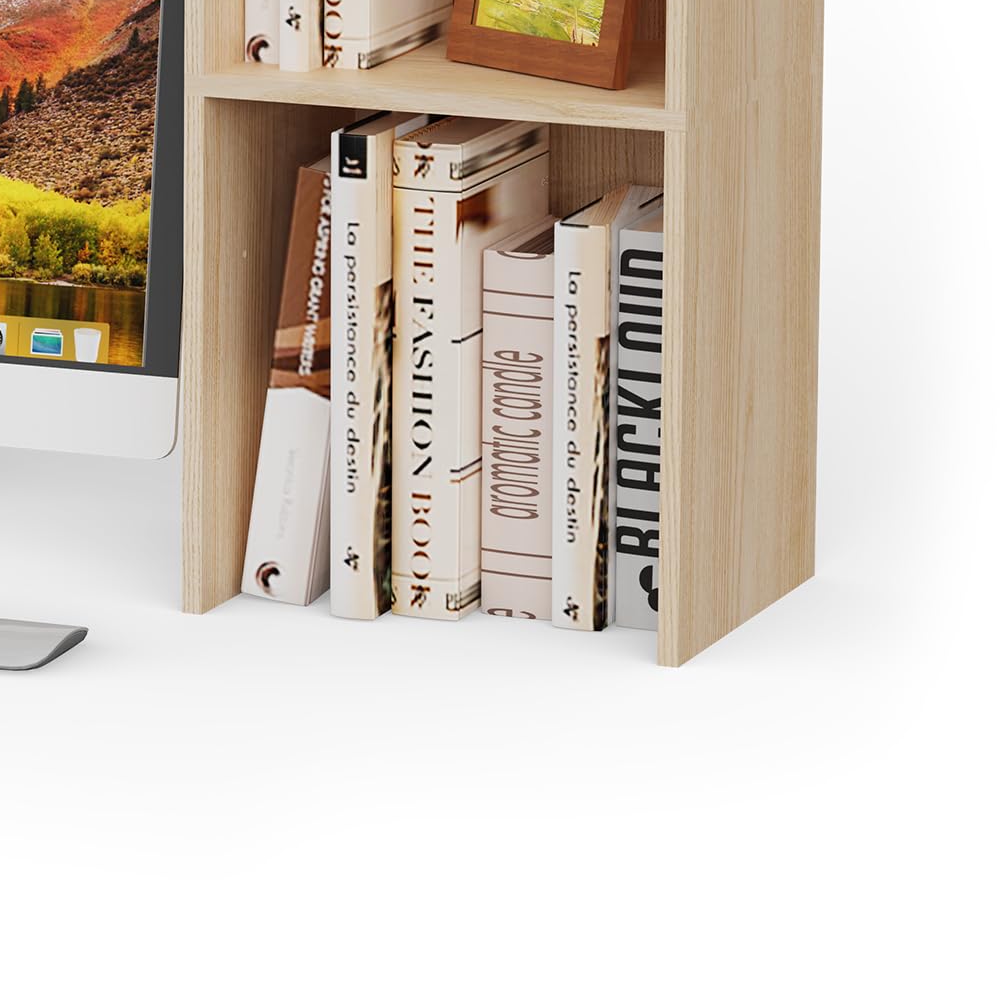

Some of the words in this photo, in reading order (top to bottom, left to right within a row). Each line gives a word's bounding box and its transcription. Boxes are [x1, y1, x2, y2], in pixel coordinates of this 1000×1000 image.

[348, 222, 360, 246] La
[412, 196, 435, 284] THE
[568, 271, 582, 295] La
[344, 255, 360, 383] persistance
[411, 296, 434, 477] FASHION
[483, 350, 544, 420] candle
[565, 304, 581, 432] persistance
[348, 392, 360, 420] du
[347, 428, 360, 494] destin
[483, 424, 542, 520] aromatic
[568, 440, 581, 469] du
[567, 478, 581, 544] destin
[410, 492, 432, 609] BOOK
